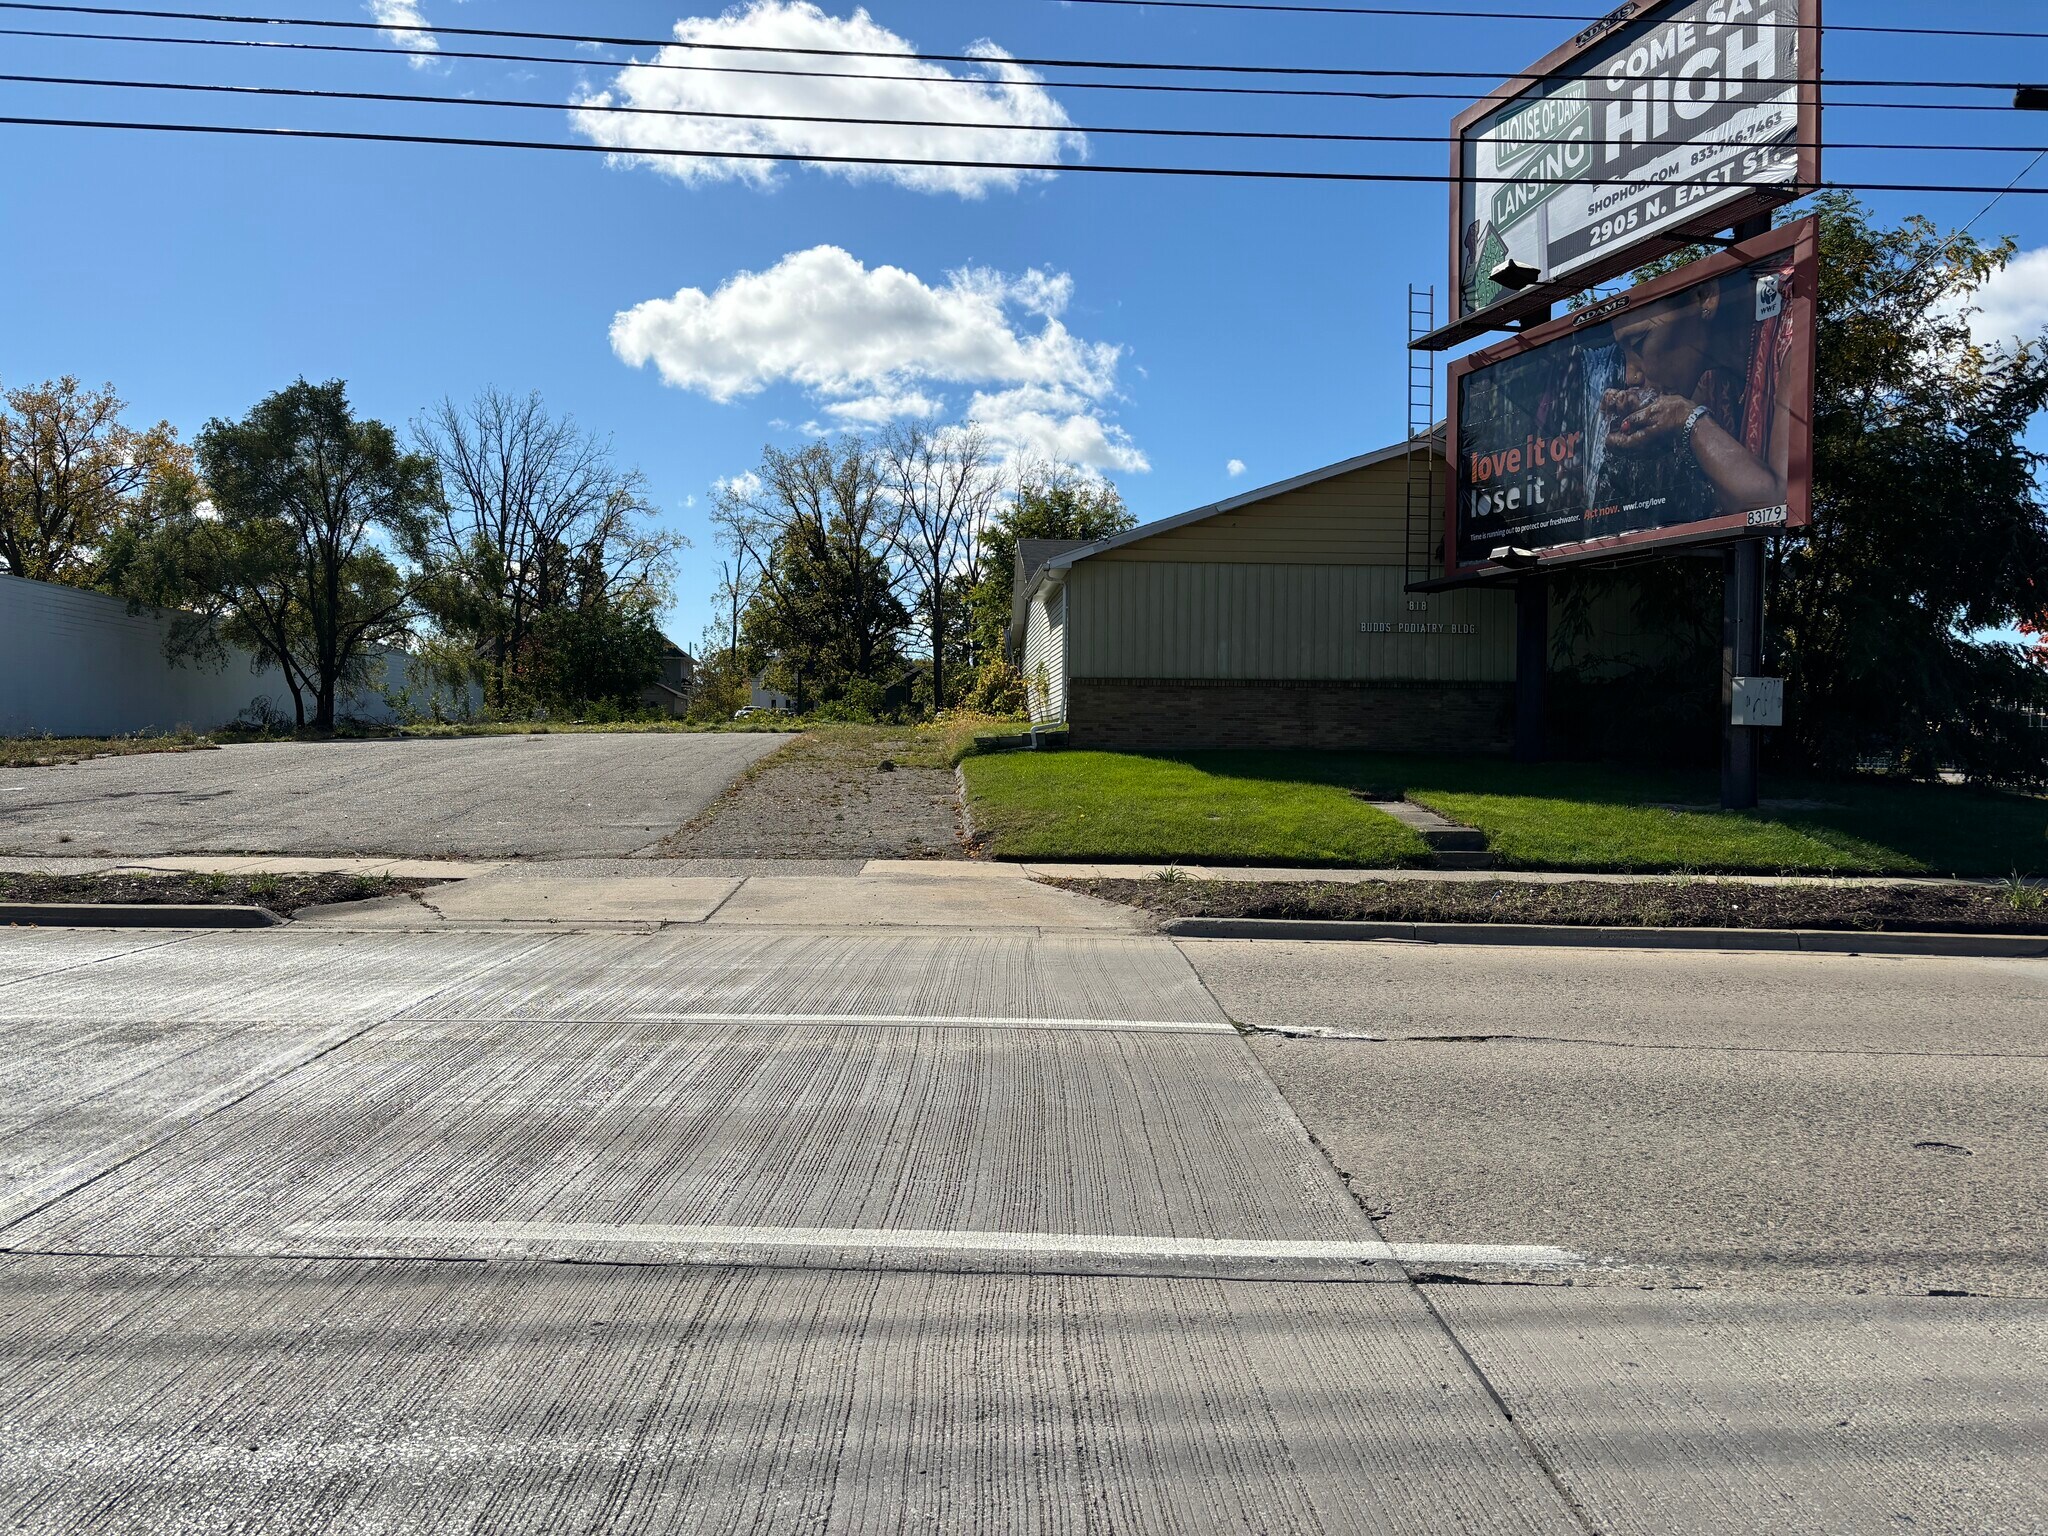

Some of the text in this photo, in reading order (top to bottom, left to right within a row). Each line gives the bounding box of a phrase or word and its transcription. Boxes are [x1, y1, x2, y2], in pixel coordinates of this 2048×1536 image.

[1606, 0, 1769, 92] COME SA
[1605, 10, 1776, 164] HIGH
[1500, 88, 1581, 158] HOUSE OF DANK
[1497, 126, 1585, 225] LANSING
[1587, 111, 1783, 217] SHOPHOD.COM 833.746.7463
[1589, 149, 1782, 247] 2905 N. EAST ST.
[1576, 298, 1627, 324] ADAMS
[1760, 303, 1777, 315] WWF
[1470, 430, 1581, 484] love it or
[1470, 474, 1546, 518] lose it
[1470, 532, 1482, 542] Time
[1487, 528, 1506, 539] running
[1506, 526, 1515, 535] out
[1521, 520, 1540, 533] protect
[1540, 519, 1550, 528] our
[1550, 514, 1581, 526] freshwater.
[1584, 508, 1600, 521] Act
[1600, 503, 1621, 515] now.
[1623, 495, 1667, 513] wwf.org/love
[1747, 506, 1782, 526] 83179
[1398, 623, 1444, 633] PODIATRY
[1451, 624, 1479, 634] BLDG.
[1408, 601, 1427, 611] 818
